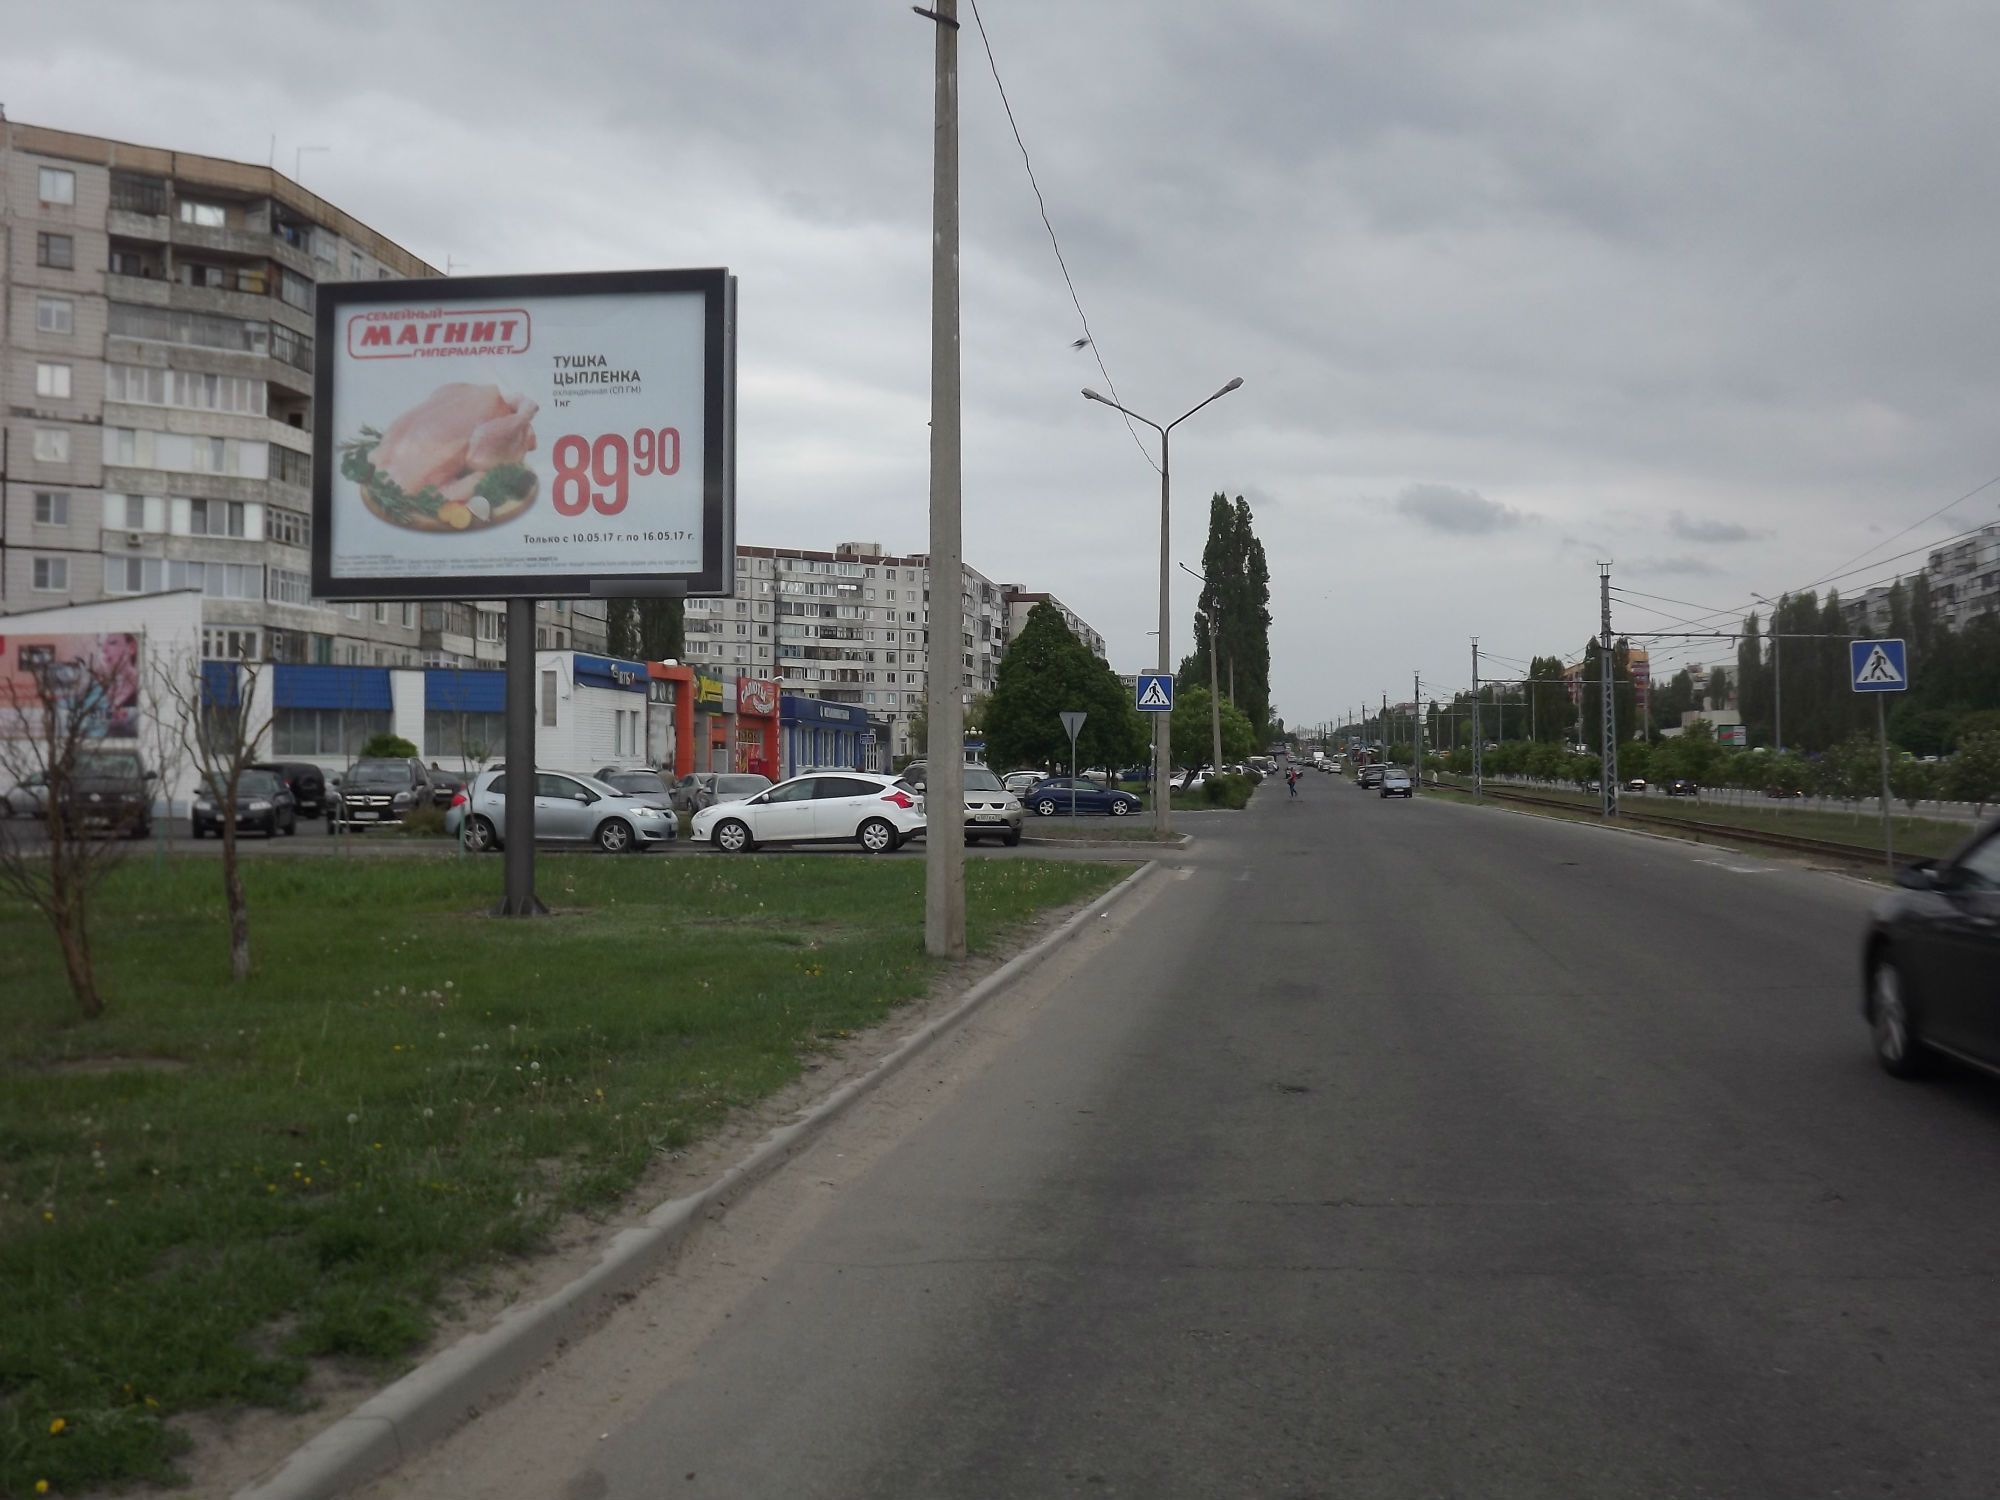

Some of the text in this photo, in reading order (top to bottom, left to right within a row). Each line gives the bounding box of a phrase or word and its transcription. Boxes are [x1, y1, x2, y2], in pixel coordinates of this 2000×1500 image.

[365, 307, 443, 322] СЕМЕЙНЫЙ
[360, 320, 519, 347] МАГНИТ
[412, 345, 515, 359] ГИПЕРМАРКЕТ
[553, 354, 608, 368] ТУШКА
[553, 370, 641, 387] ЦЫПЛЕНКА
[552, 427, 680, 517] 89 90
[523, 534, 560, 544] Только
[572, 533, 614, 543] 10.05.17
[626, 534, 639, 542] по
[643, 531, 685, 541] 16.05.17
[687, 532, 695, 541] г.
